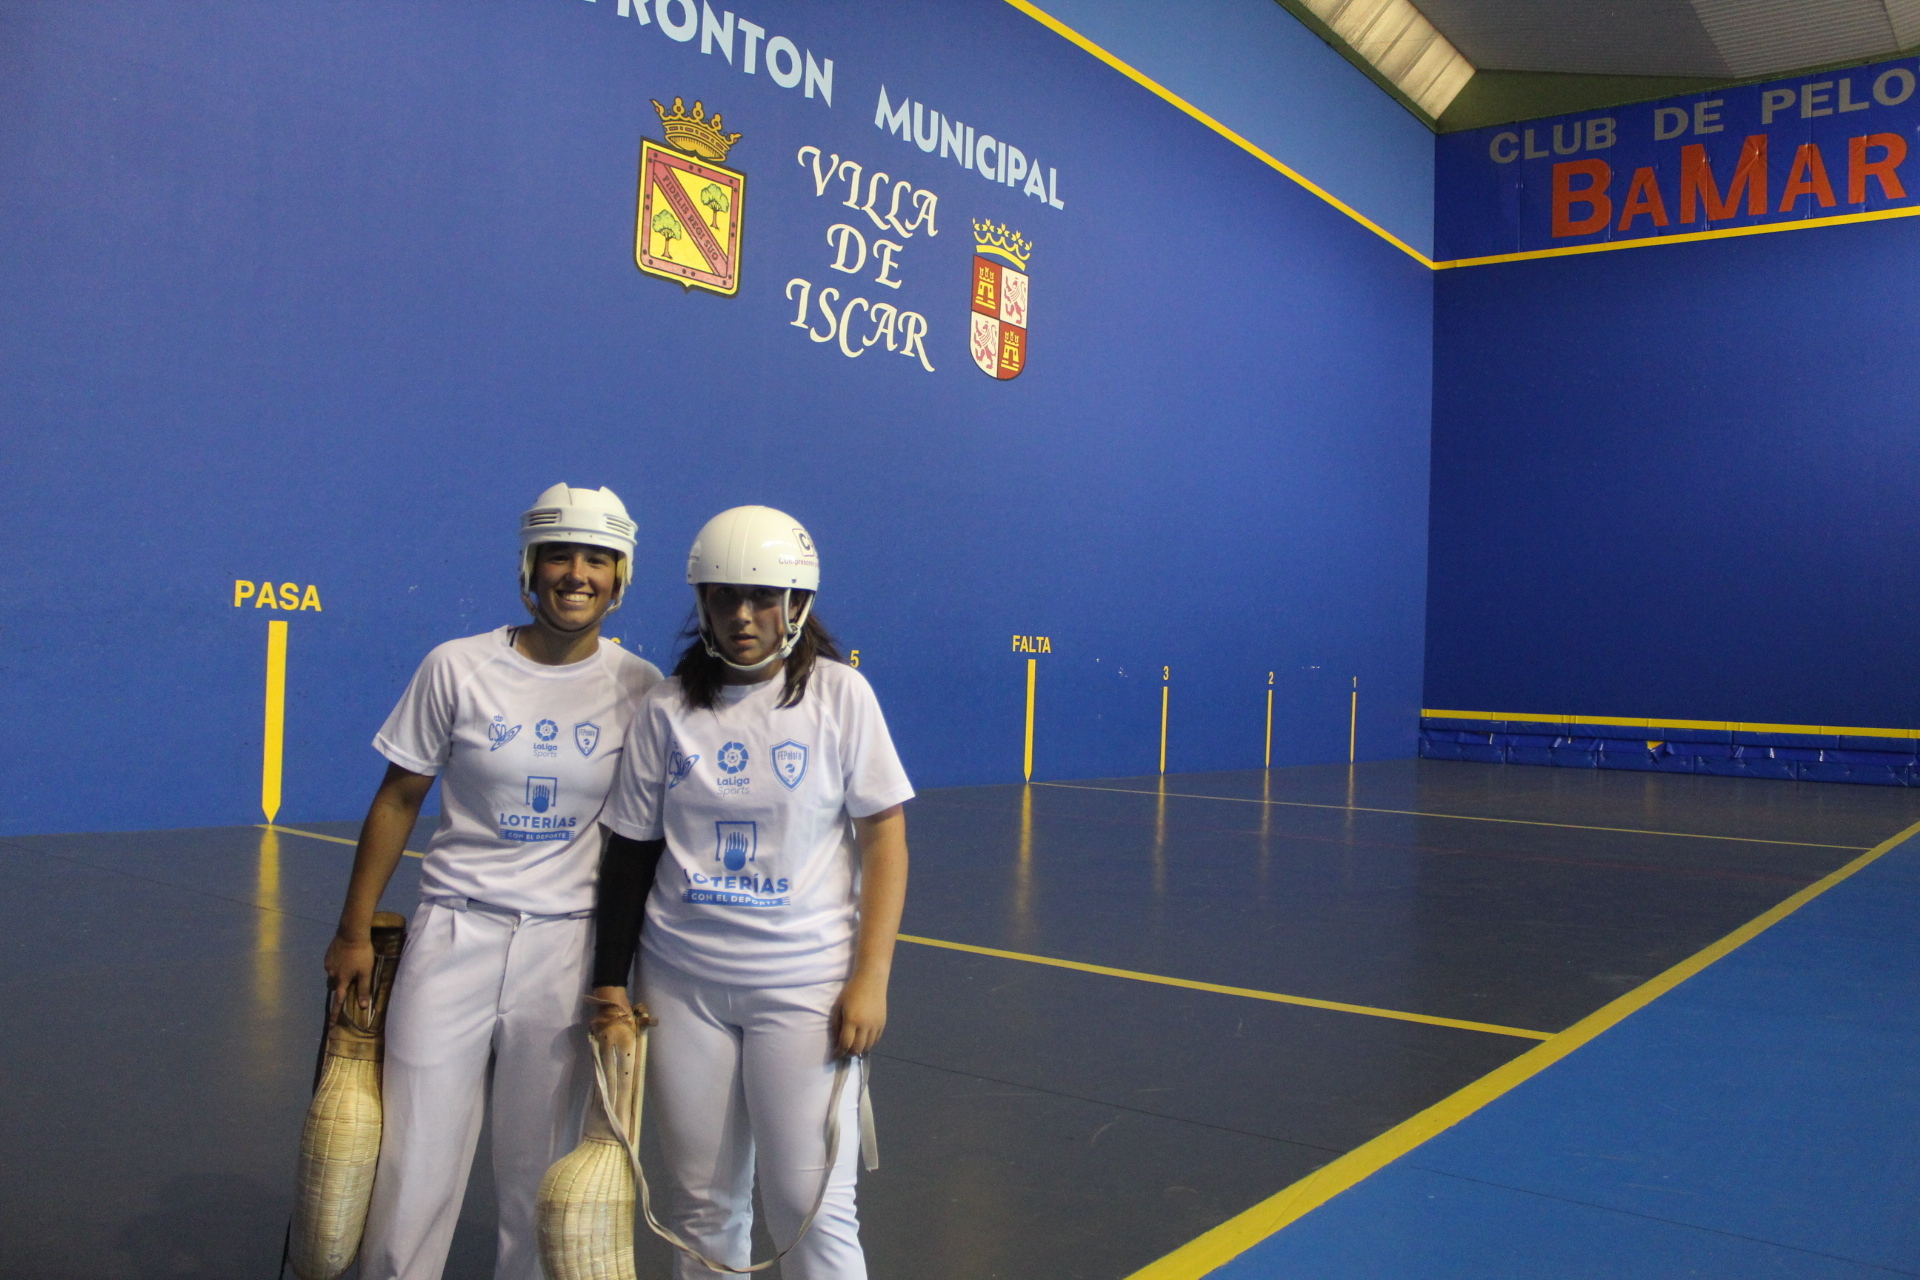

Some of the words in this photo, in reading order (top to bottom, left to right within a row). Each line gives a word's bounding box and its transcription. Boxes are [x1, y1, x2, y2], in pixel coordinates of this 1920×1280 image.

[584, 0, 834, 108] ONTON
[874, 83, 1065, 210] MUNICIPAL
[1489, 117, 1617, 164] CLUB
[1654, 99, 1725, 141] DE
[1762, 66, 1920, 125] PELO
[797, 145, 938, 239] VILLA
[662, 174, 690, 215] FIDELIS
[687, 214, 706, 241] REGI
[703, 238, 720, 261] SUO
[826, 223, 903, 290] DE
[785, 278, 935, 372] ISCAR
[234, 579, 322, 612] PASA
[1012, 635, 1051, 653] FALTA
[850, 650, 859, 668] 5
[1163, 666, 1169, 681] 3
[1268, 671, 1274, 684] 2
[1352, 676, 1357, 688] 1
[533, 743, 558, 752] LaLiga
[533, 749, 558, 758] Sports
[717, 776, 750, 786] LaLiga
[717, 786, 750, 797] Sports
[500, 813, 577, 829] LOTERÍAS
[536, 832, 566, 840] DEPORTE
[691, 893, 713, 901] CON
[731, 895, 778, 906] DEPORTE
